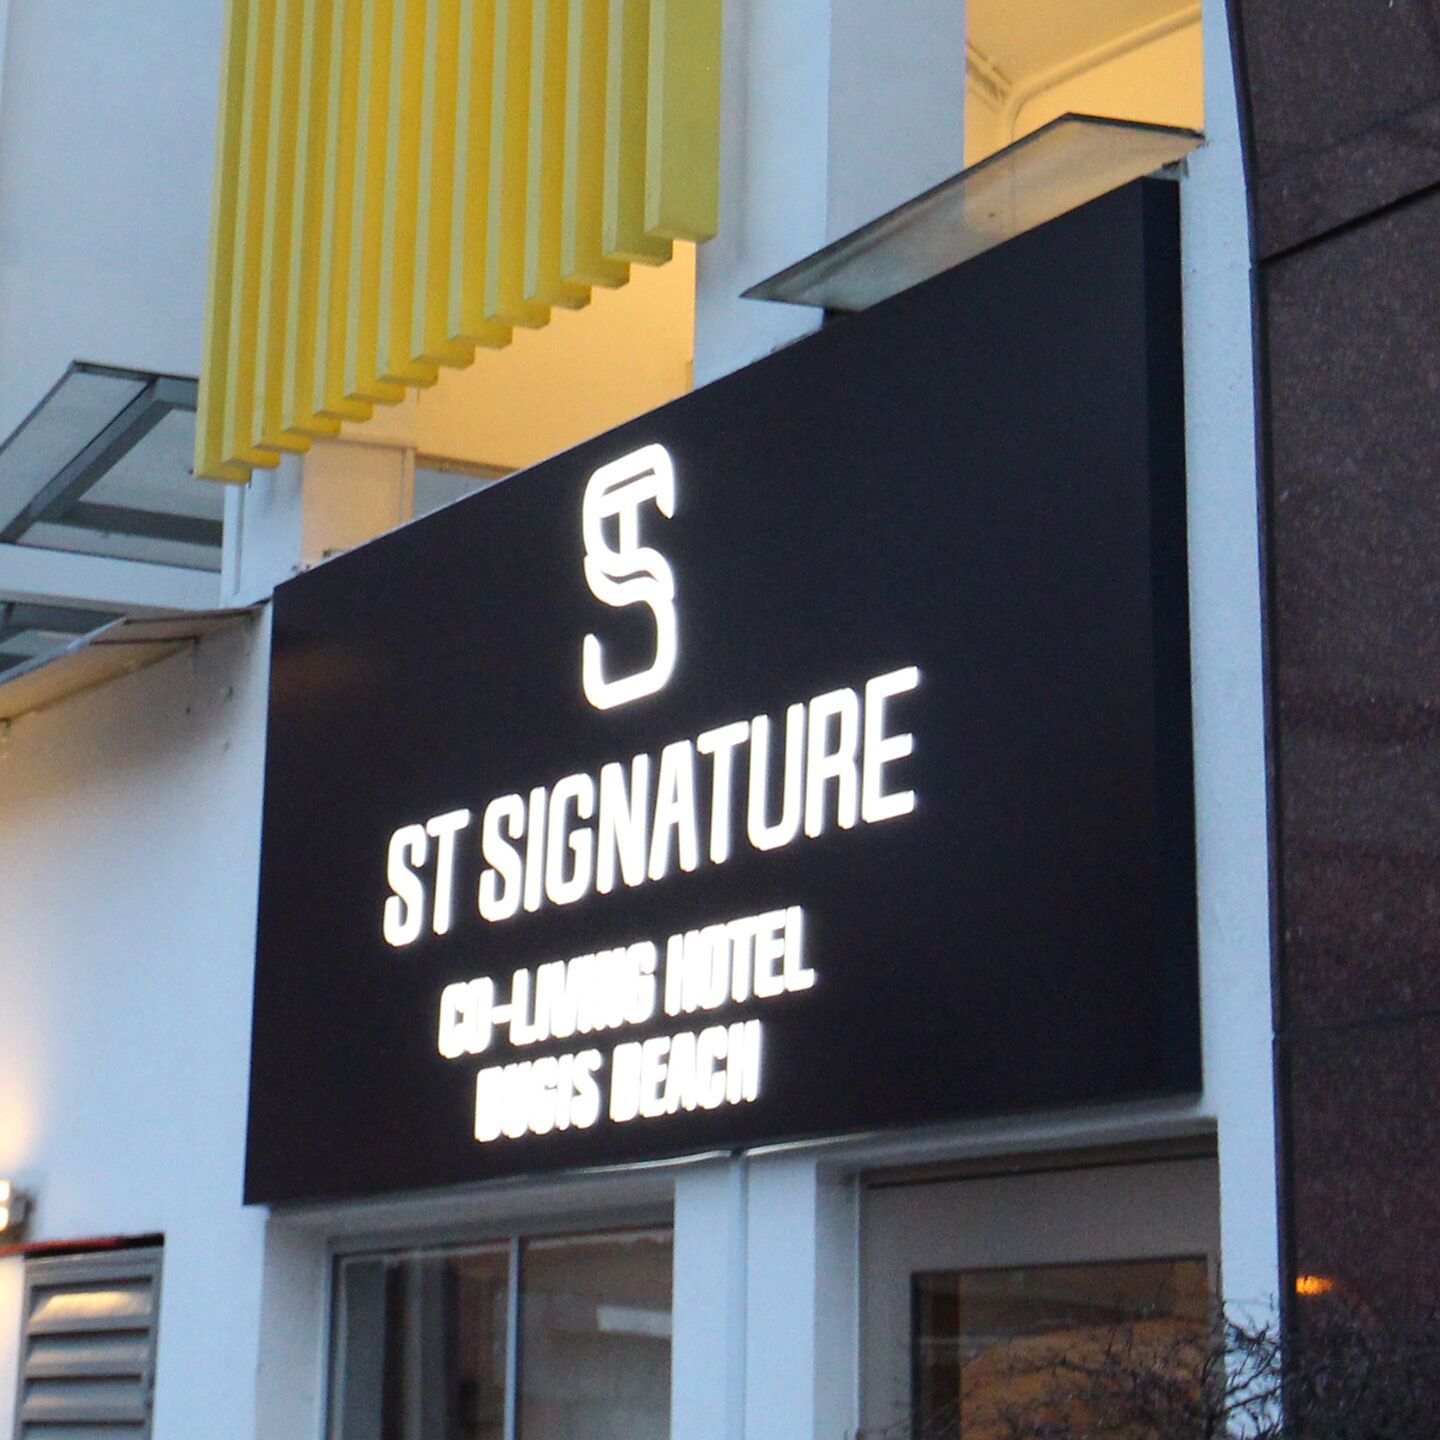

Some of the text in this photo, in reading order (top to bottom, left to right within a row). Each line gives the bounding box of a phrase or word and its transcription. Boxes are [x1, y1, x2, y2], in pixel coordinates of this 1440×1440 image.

[382, 665, 920, 947] ST SIGNATURE
[437, 904, 816, 1060] CO-LIVING HOTEL
[474, 1018, 763, 1143] BUGIS BEACH
